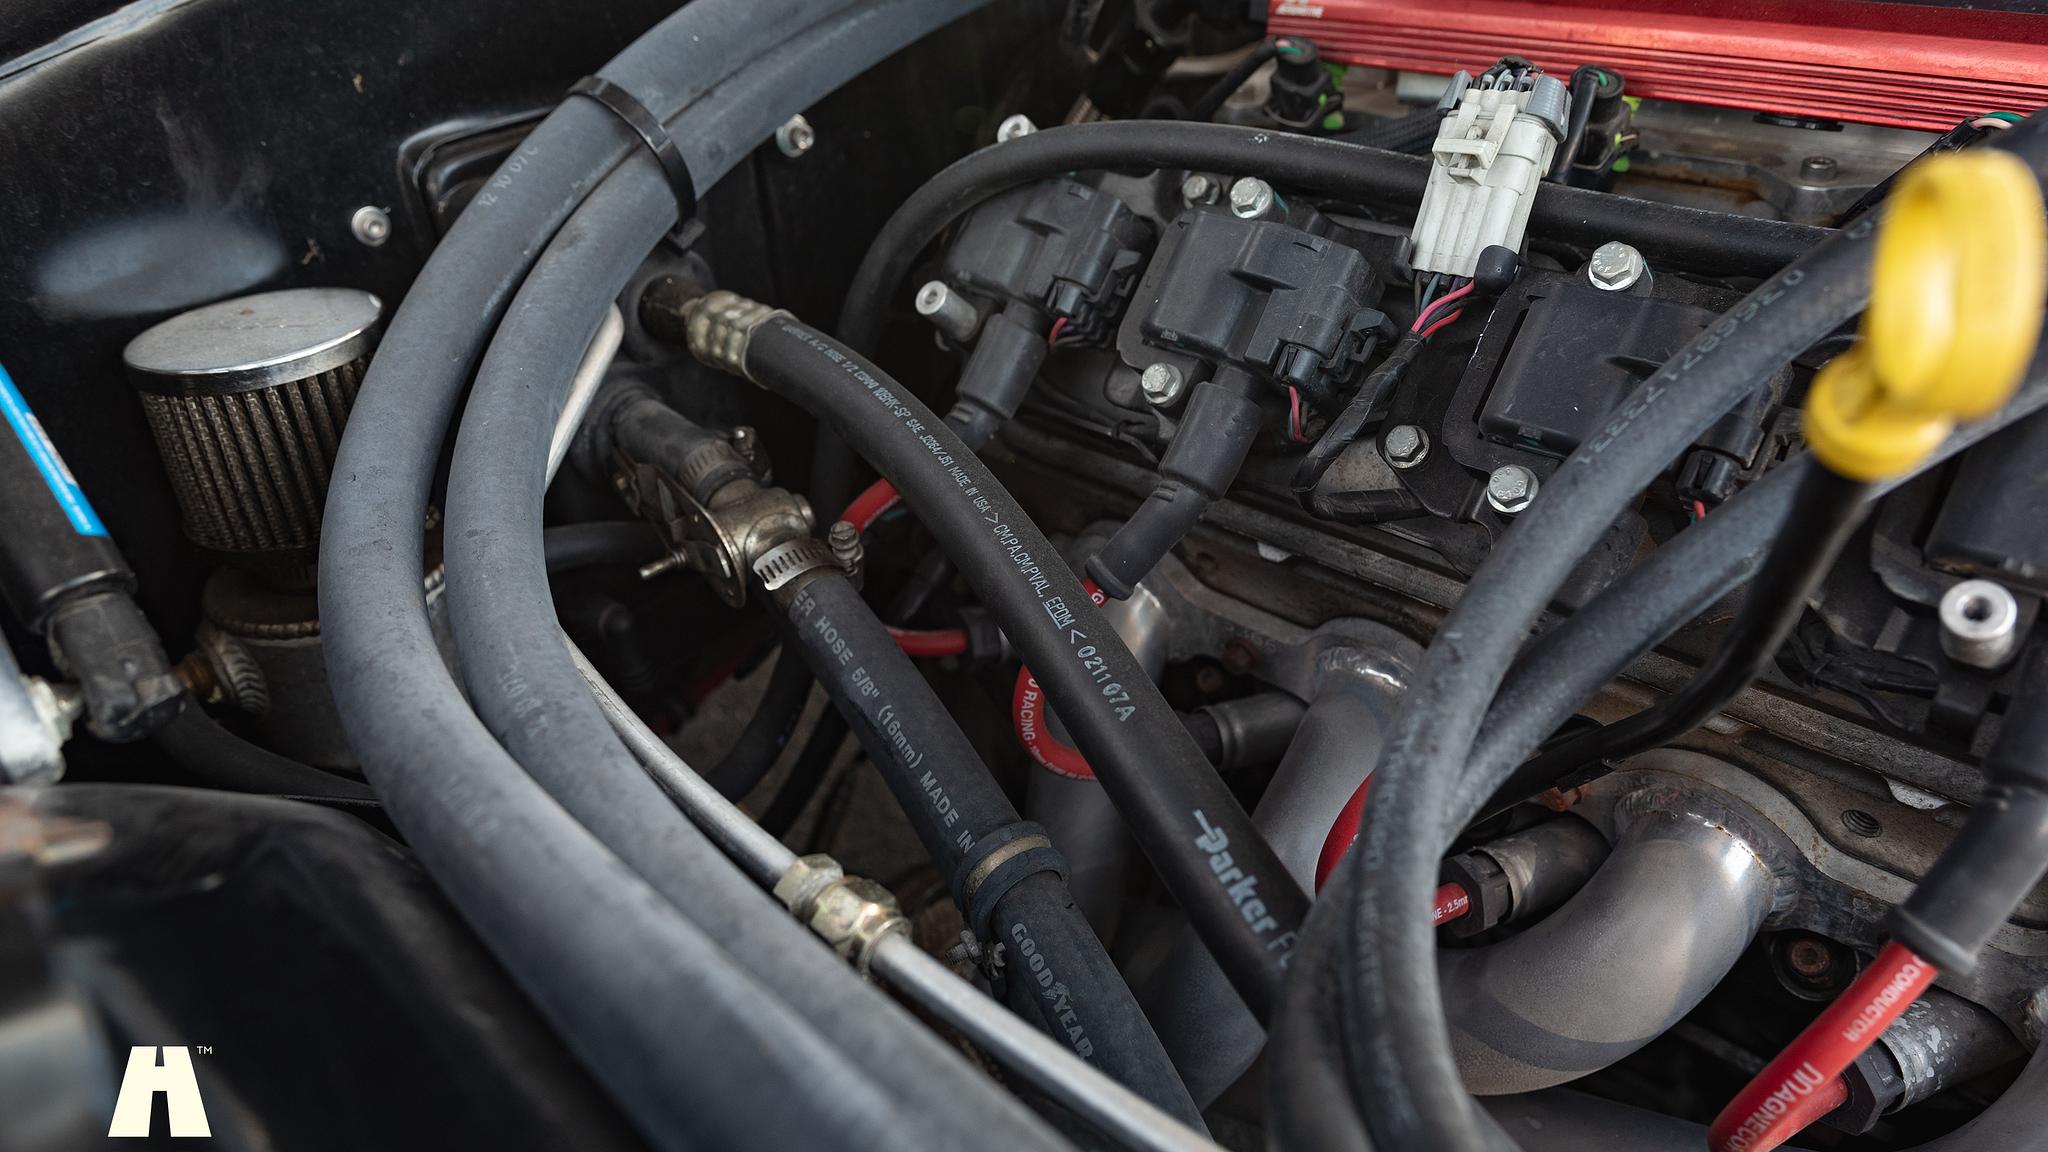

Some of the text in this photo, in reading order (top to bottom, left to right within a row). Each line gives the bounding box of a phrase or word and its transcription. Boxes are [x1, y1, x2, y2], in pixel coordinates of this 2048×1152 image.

[905, 418, 926, 434] SAE
[948, 466, 972, 488] MADE
[965, 486, 979, 497] IN
[972, 496, 992, 514] USA
[1043, 596, 1076, 630] EPDM
[815, 616, 853, 666] HOSE
[852, 666, 880, 698] 5/8"
[876, 704, 923, 769] (16mm)
[920, 769, 960, 829] MADE
[956, 829, 976, 854] IN
[1020, 689, 1039, 742] RACING
[1192, 808, 1280, 935] Parker
[1842, 961, 1921, 1043] CONDUCTOR
